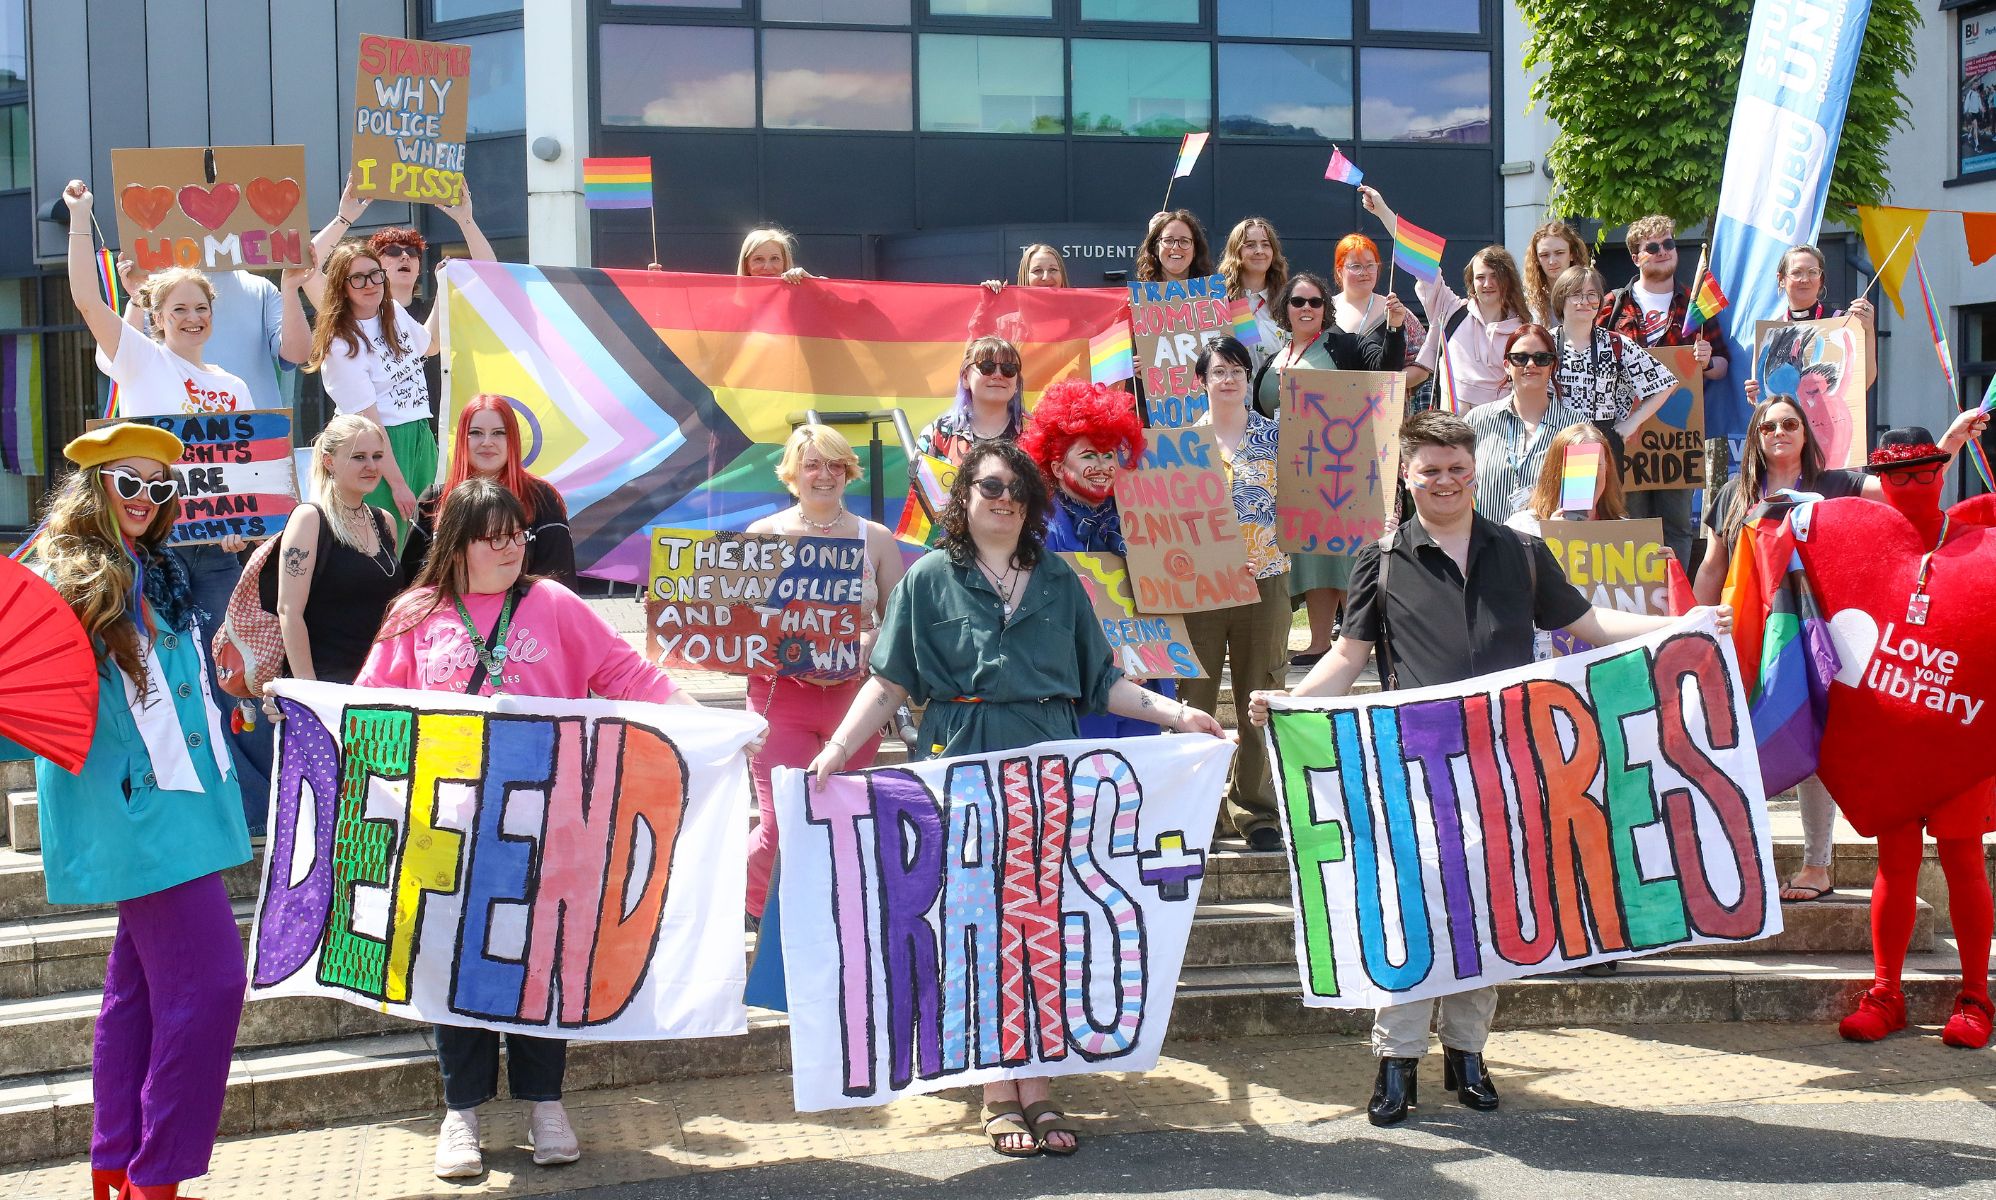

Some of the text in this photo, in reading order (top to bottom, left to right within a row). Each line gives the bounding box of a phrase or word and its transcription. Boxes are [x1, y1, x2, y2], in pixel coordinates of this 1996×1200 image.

[1757, 0, 1792, 80] STU
[1778, 0, 1836, 94] UN
[1966, 22, 1979, 38] BU
[1817, 0, 1848, 103] BOURNEMOU
[374, 76, 452, 114] WHY
[357, 107, 440, 138] POLICE
[395, 136, 466, 172] WHERE
[357, 159, 464, 205] I PISS?
[1771, 119, 1813, 237] SUBU
[134, 229, 301, 271] WOMEN
[1062, 245, 1137, 258] STUDENT
[1127, 273, 1227, 305] TRANS
[1132, 298, 1233, 337] WOMEN
[1147, 367, 1202, 397] RE
[128, 415, 254, 442] RANS
[1146, 393, 1210, 428] WOM
[182, 440, 252, 464] GHTS
[1641, 430, 1703, 450] QUEER
[1624, 450, 1704, 486] PRIDE
[175, 495, 258, 520] MAN
[1114, 470, 1225, 509] BINGO
[1124, 508, 1237, 549] 2NITE
[1276, 507, 1386, 543] TRANS
[659, 537, 864, 572] THERE'S ONLY
[1302, 534, 1363, 556] JOY
[1546, 537, 1667, 585] BEING
[655, 575, 863, 602] ONE WAY OF LIFE
[1139, 563, 1257, 609] DYLANS
[1575, 584, 1668, 616] ANS
[655, 604, 855, 635] AND THAT'S
[1102, 618, 1172, 646] BEING
[424, 622, 548, 684] Baie
[656, 632, 777, 669] YOUR
[1113, 642, 1200, 678] ANS
[1880, 622, 1959, 674] Love
[1867, 658, 1984, 725] library
[1912, 665, 1953, 687] your
[1267, 631, 1766, 998] FUTURES
[251, 696, 690, 1028] DEFEND
